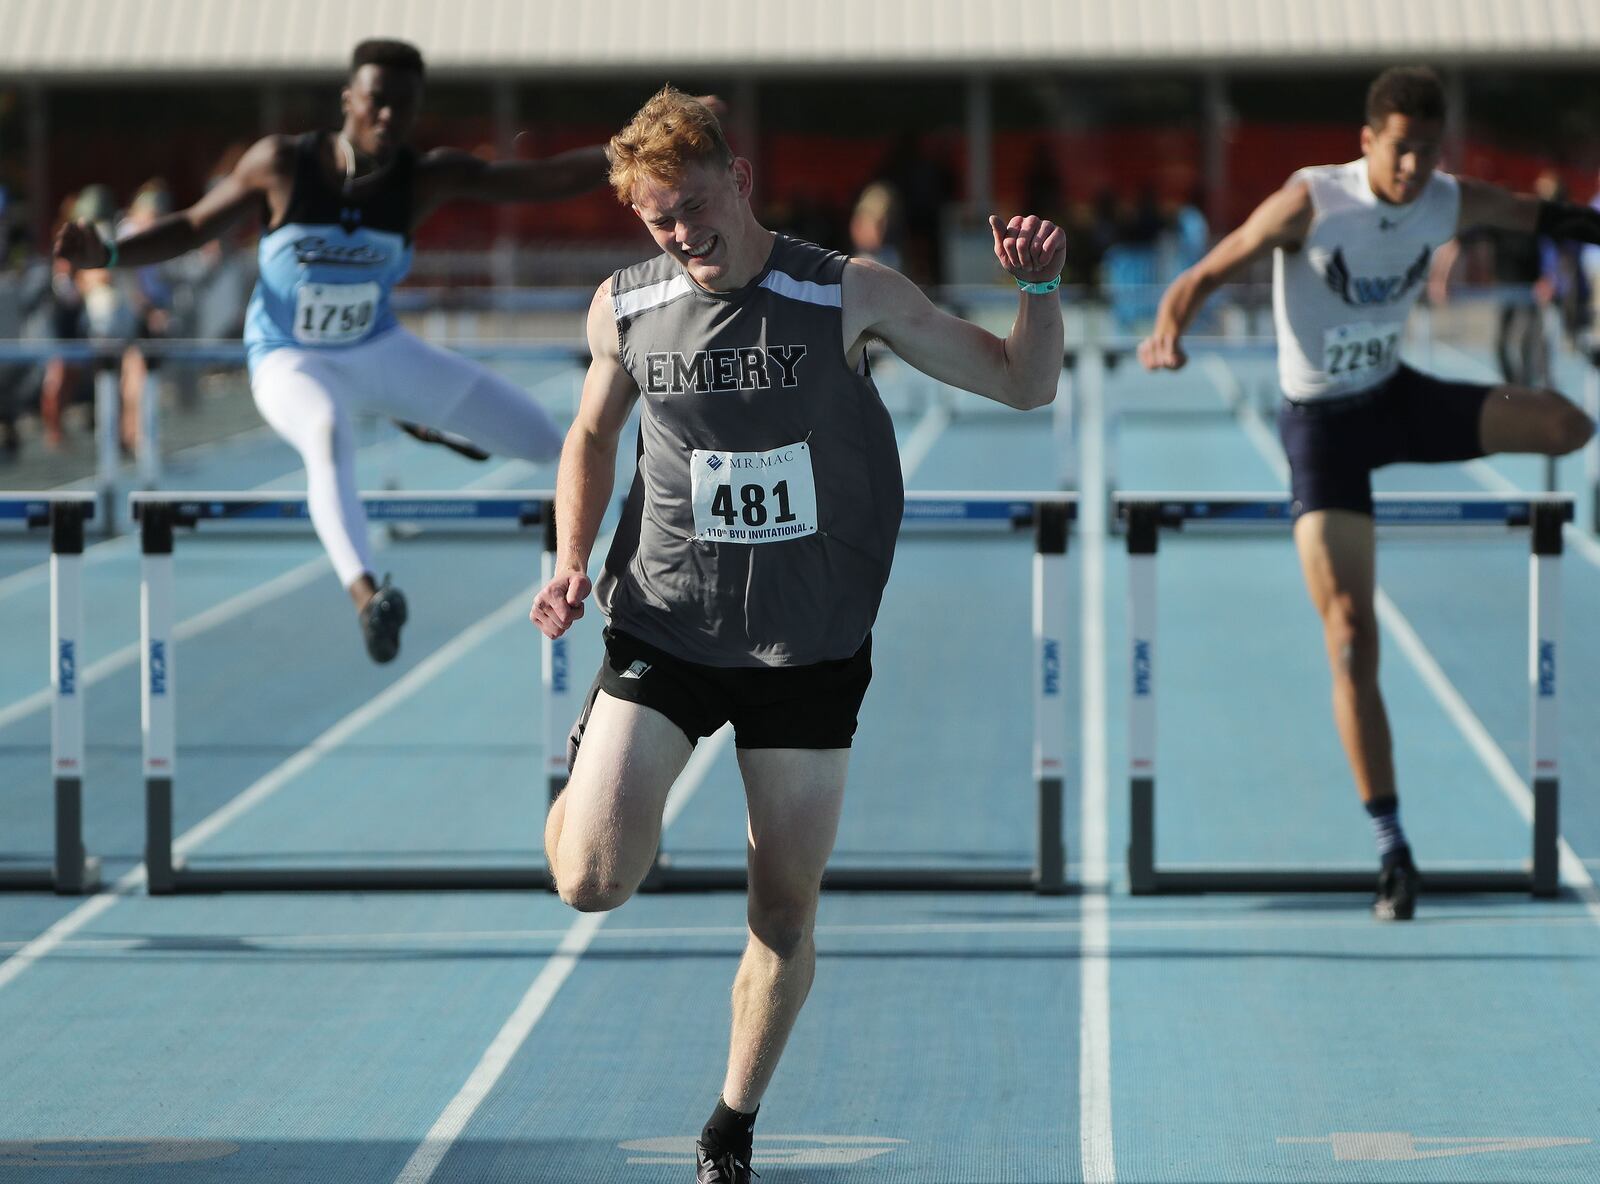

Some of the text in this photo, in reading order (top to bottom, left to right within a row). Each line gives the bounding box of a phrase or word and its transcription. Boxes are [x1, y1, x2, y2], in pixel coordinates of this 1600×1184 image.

[645, 345, 807, 394] EMERY
[711, 480, 796, 526] 481
[729, 529, 746, 539] BYU
[748, 523, 807, 539] INVITATIONAL
